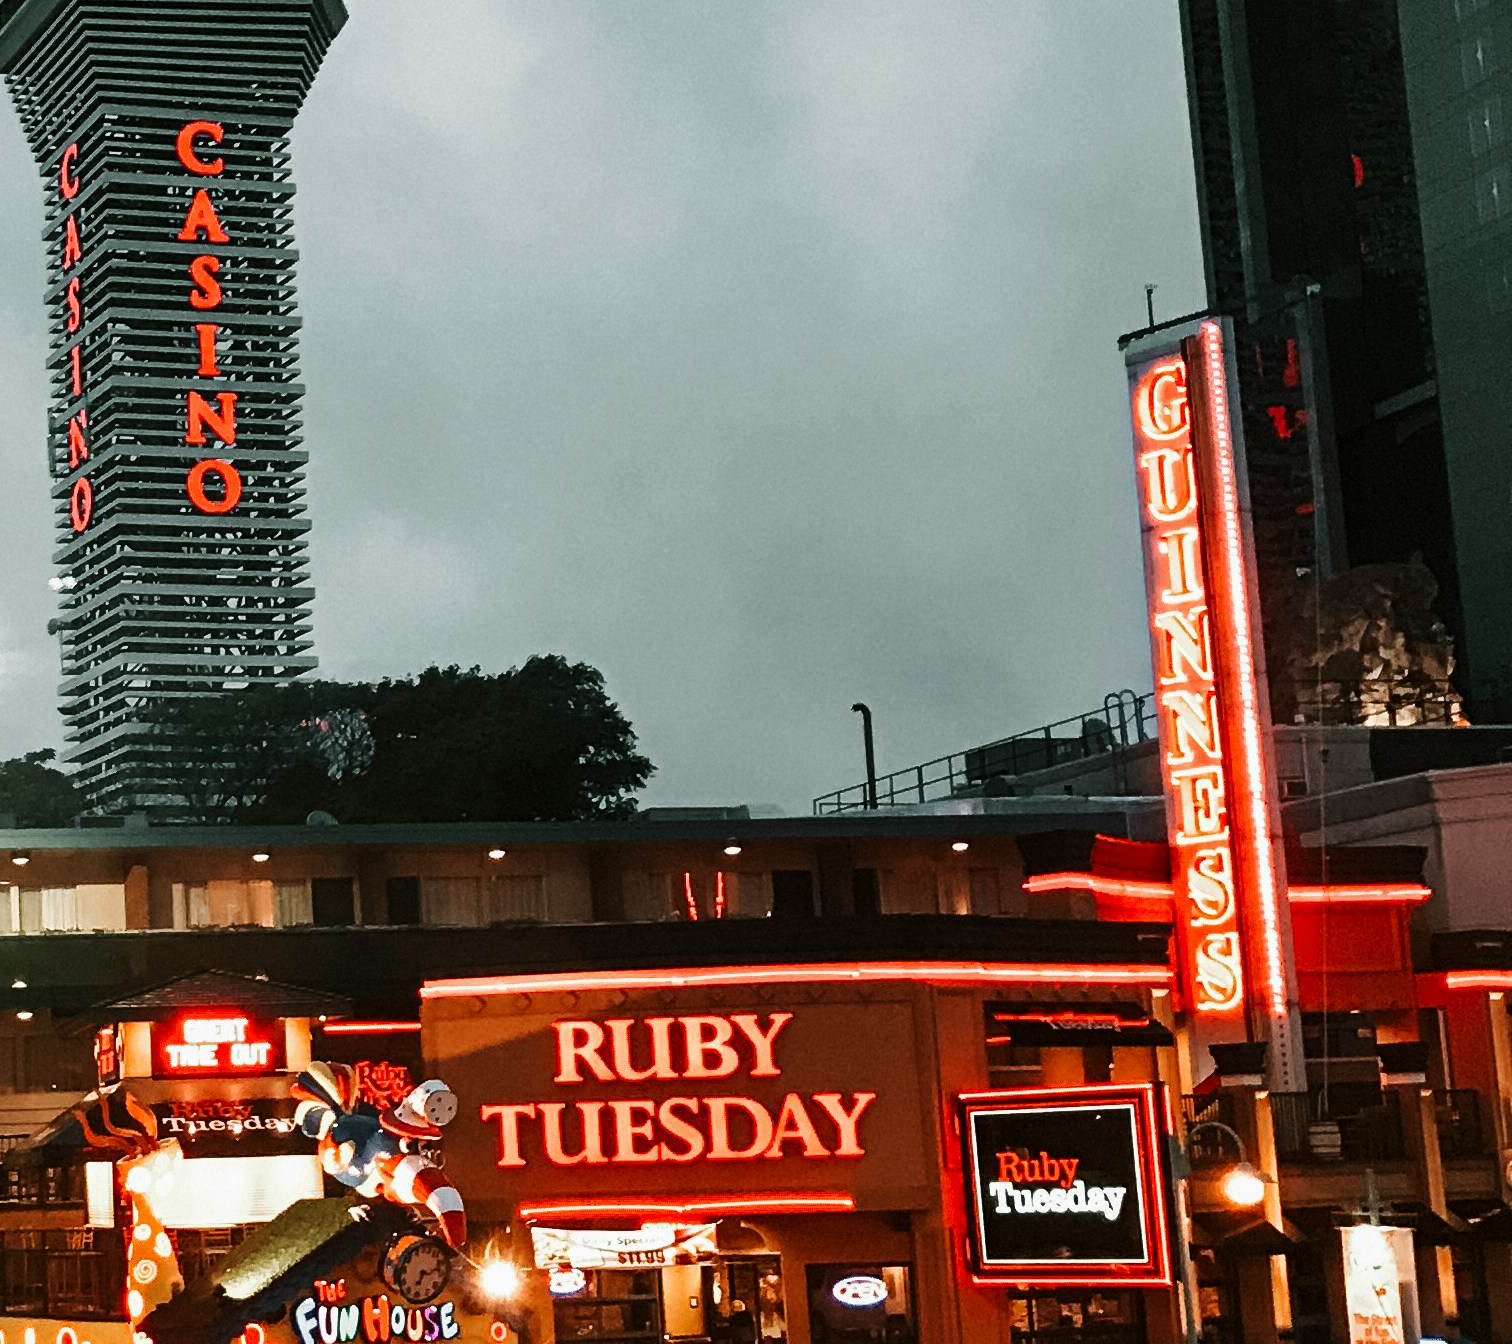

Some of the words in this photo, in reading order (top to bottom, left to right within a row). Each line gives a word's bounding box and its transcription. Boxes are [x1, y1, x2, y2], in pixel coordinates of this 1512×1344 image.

[59, 142, 93, 532] CASINO
[175, 121, 243, 515] CASINO
[1134, 360, 1244, 1013] GUINNESS
[552, 1012, 793, 1084] RUBY
[162, 1115, 297, 1133] Tuesday
[480, 1091, 878, 1168] TUESDAY
[988, 1179, 1126, 1221] Tuesday
[996, 1151, 1079, 1189] Ruby
[314, 1278, 347, 1303] THE
[362, 1294, 459, 1344] HOUSE
